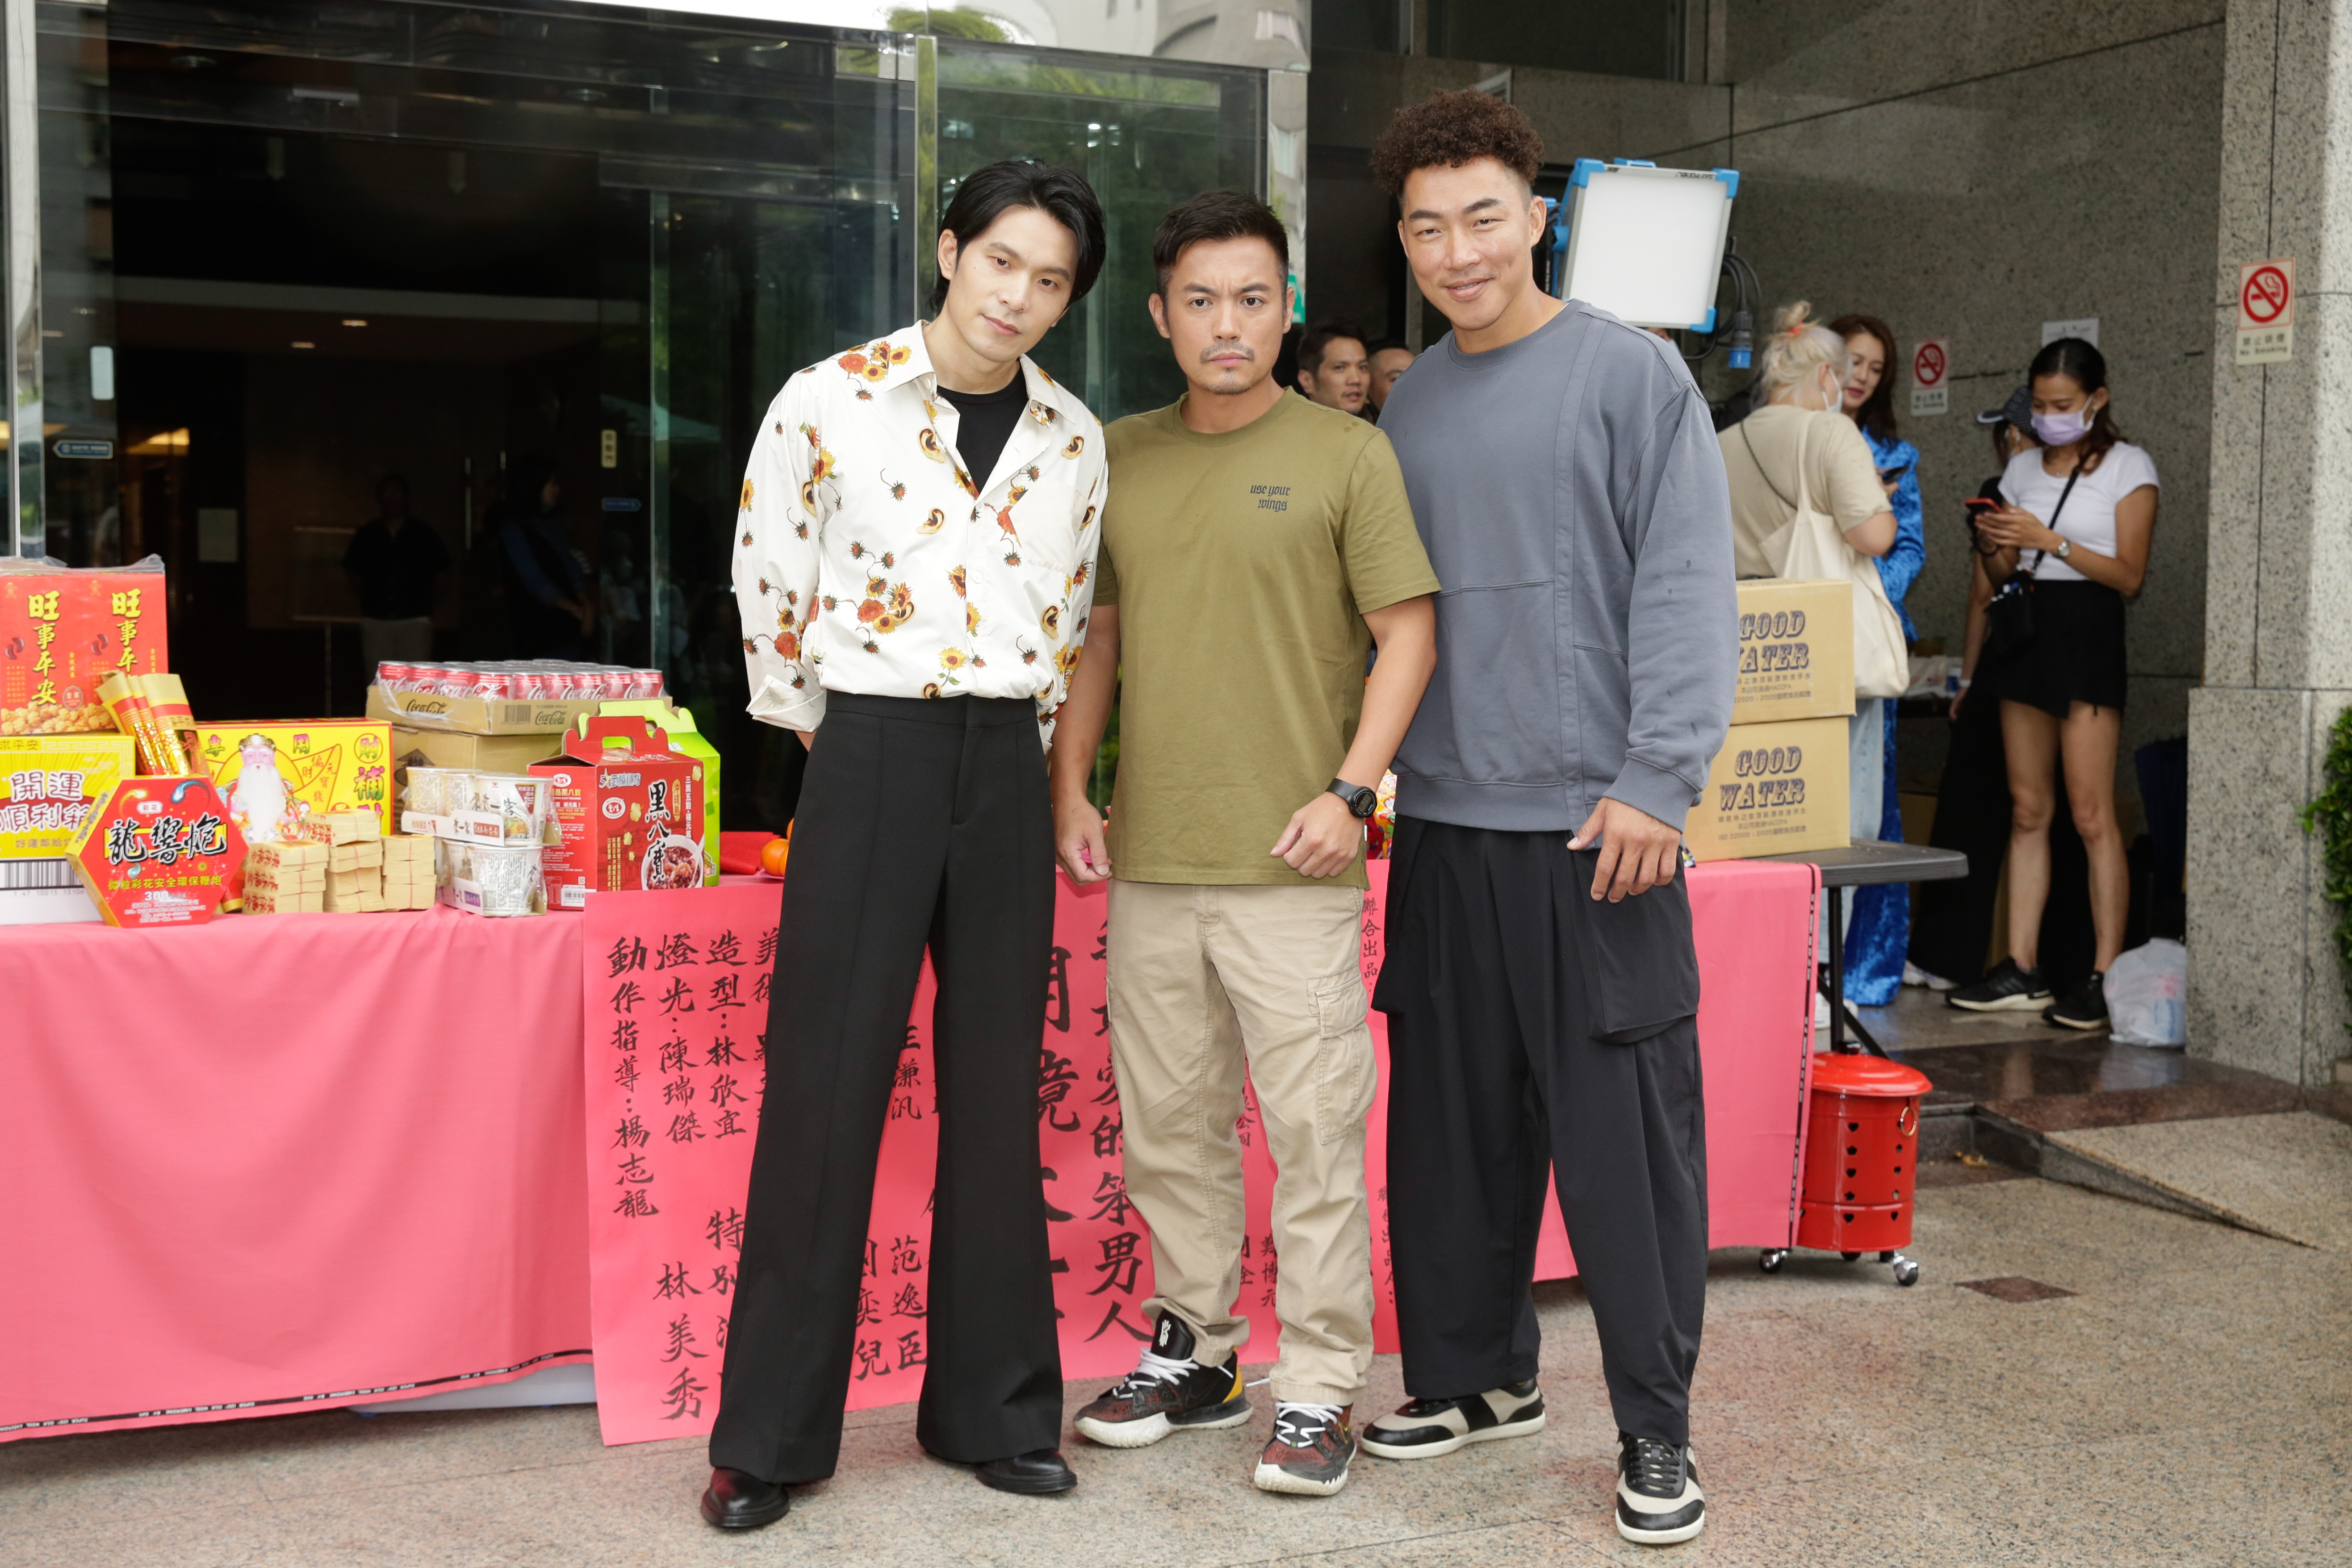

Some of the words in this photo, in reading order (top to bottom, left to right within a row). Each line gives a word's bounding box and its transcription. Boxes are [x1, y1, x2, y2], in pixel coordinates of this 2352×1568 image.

[1250, 485, 1268, 494] use
[1268, 485, 1291, 497] your
[1258, 498, 1288, 512] wings
[112, 588, 142, 678] 旺事平
[1739, 610, 1805, 640] GOOD
[28, 590, 61, 706] 旺事平安
[1738, 642, 1809, 673] ATER
[293, 733, 310, 754] 用
[1734, 745, 1802, 778] GOOD
[10, 769, 85, 803] 開運
[1719, 778, 1805, 811] WATER
[890, 1235, 928, 1370] 范逸臣
[653, 1261, 709, 1420] 林美秀
